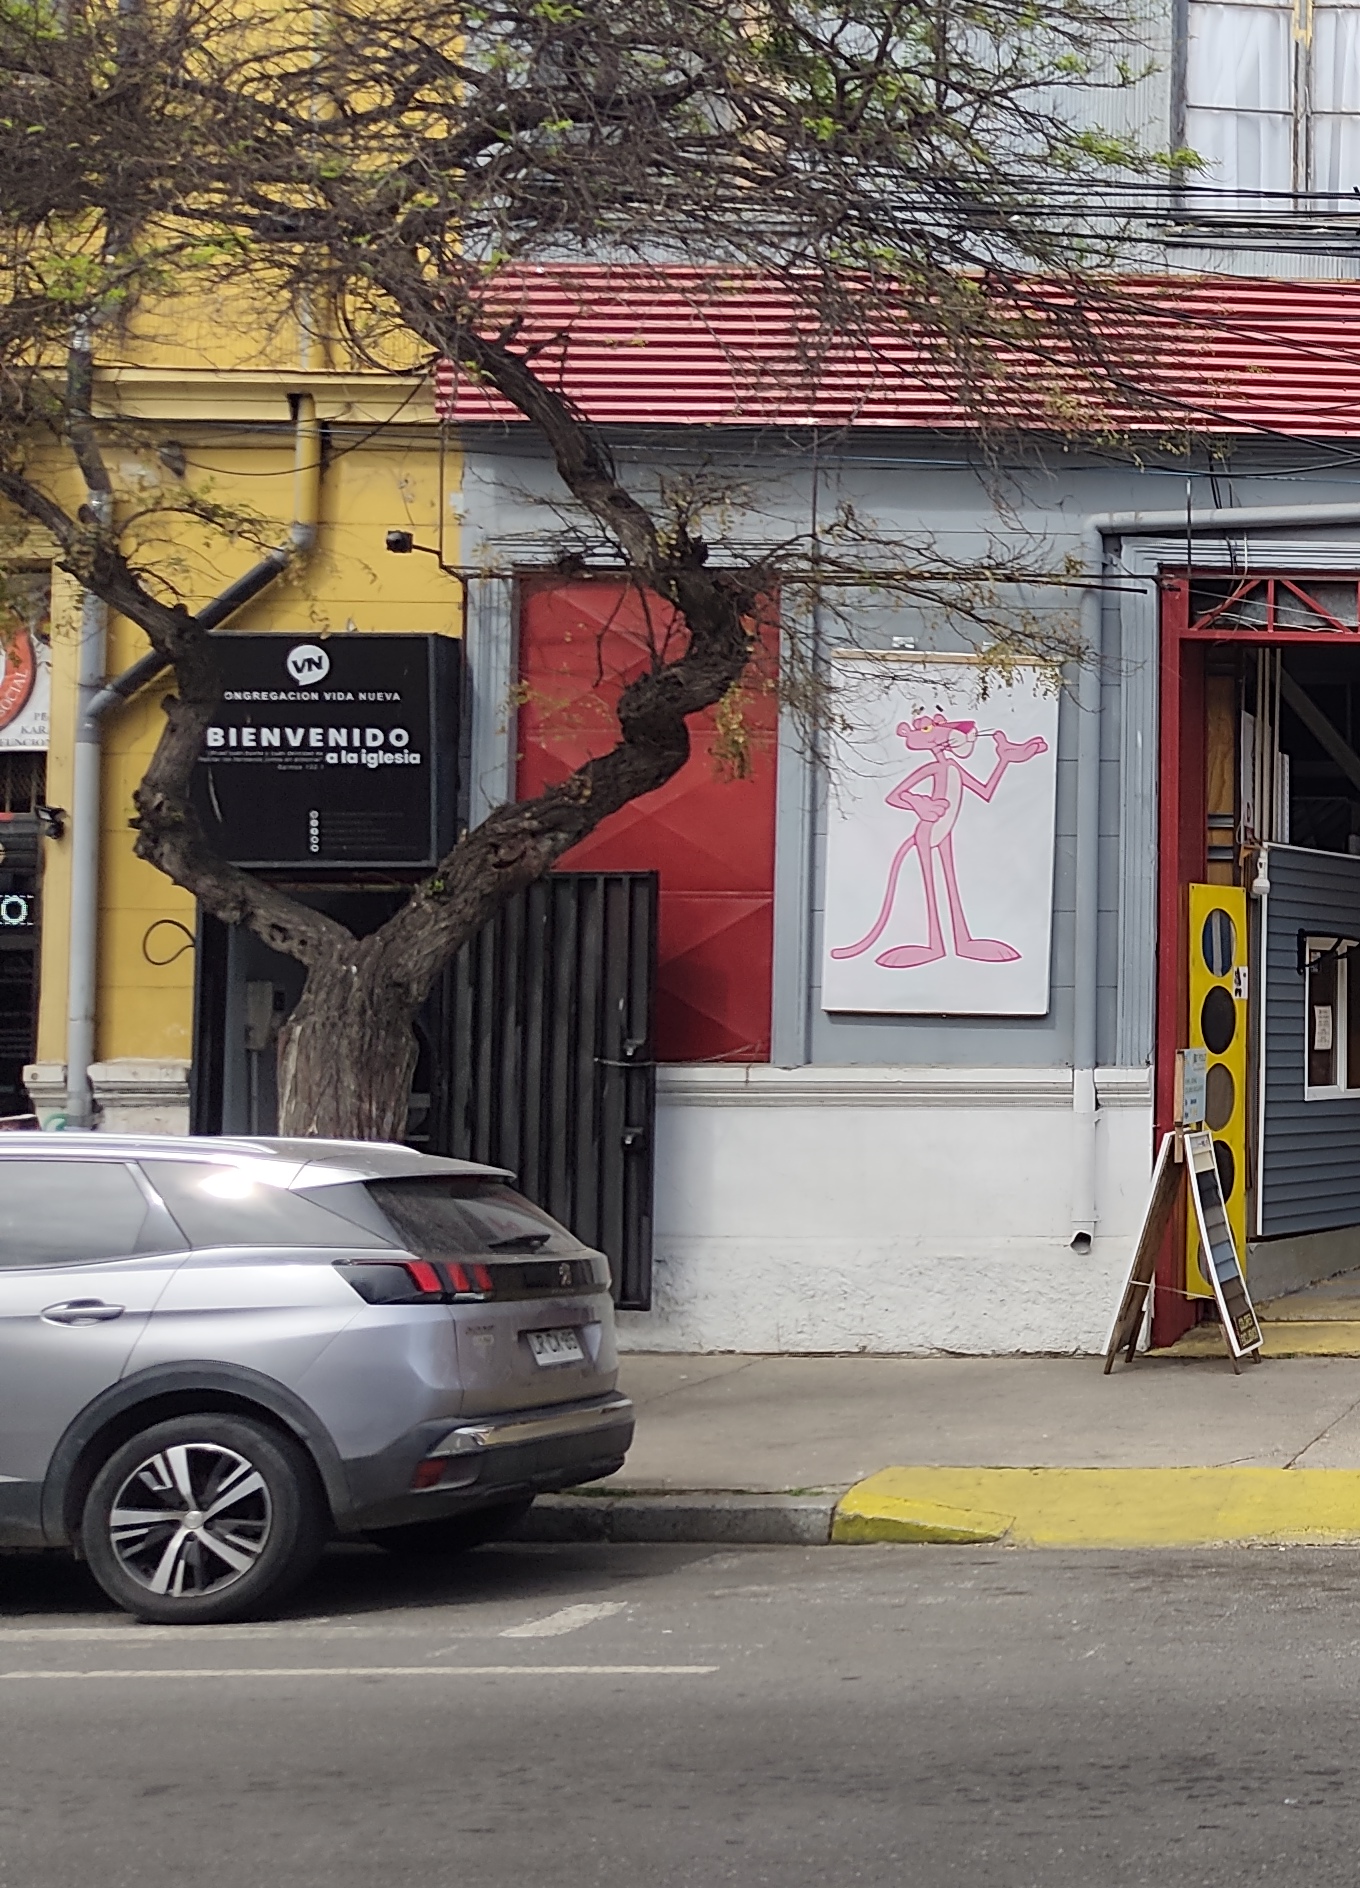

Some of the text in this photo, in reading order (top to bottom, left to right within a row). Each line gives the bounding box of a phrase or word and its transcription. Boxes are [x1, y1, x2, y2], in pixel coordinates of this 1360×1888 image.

[291, 655, 324, 674] VN
[223, 691, 401, 701] ONGREGACION VIDA NUEVA
[206, 726, 410, 748] BIENVENIDO
[325, 752, 339, 765] a
[341, 750, 359, 765] la
[361, 749, 421, 769] iglesia
